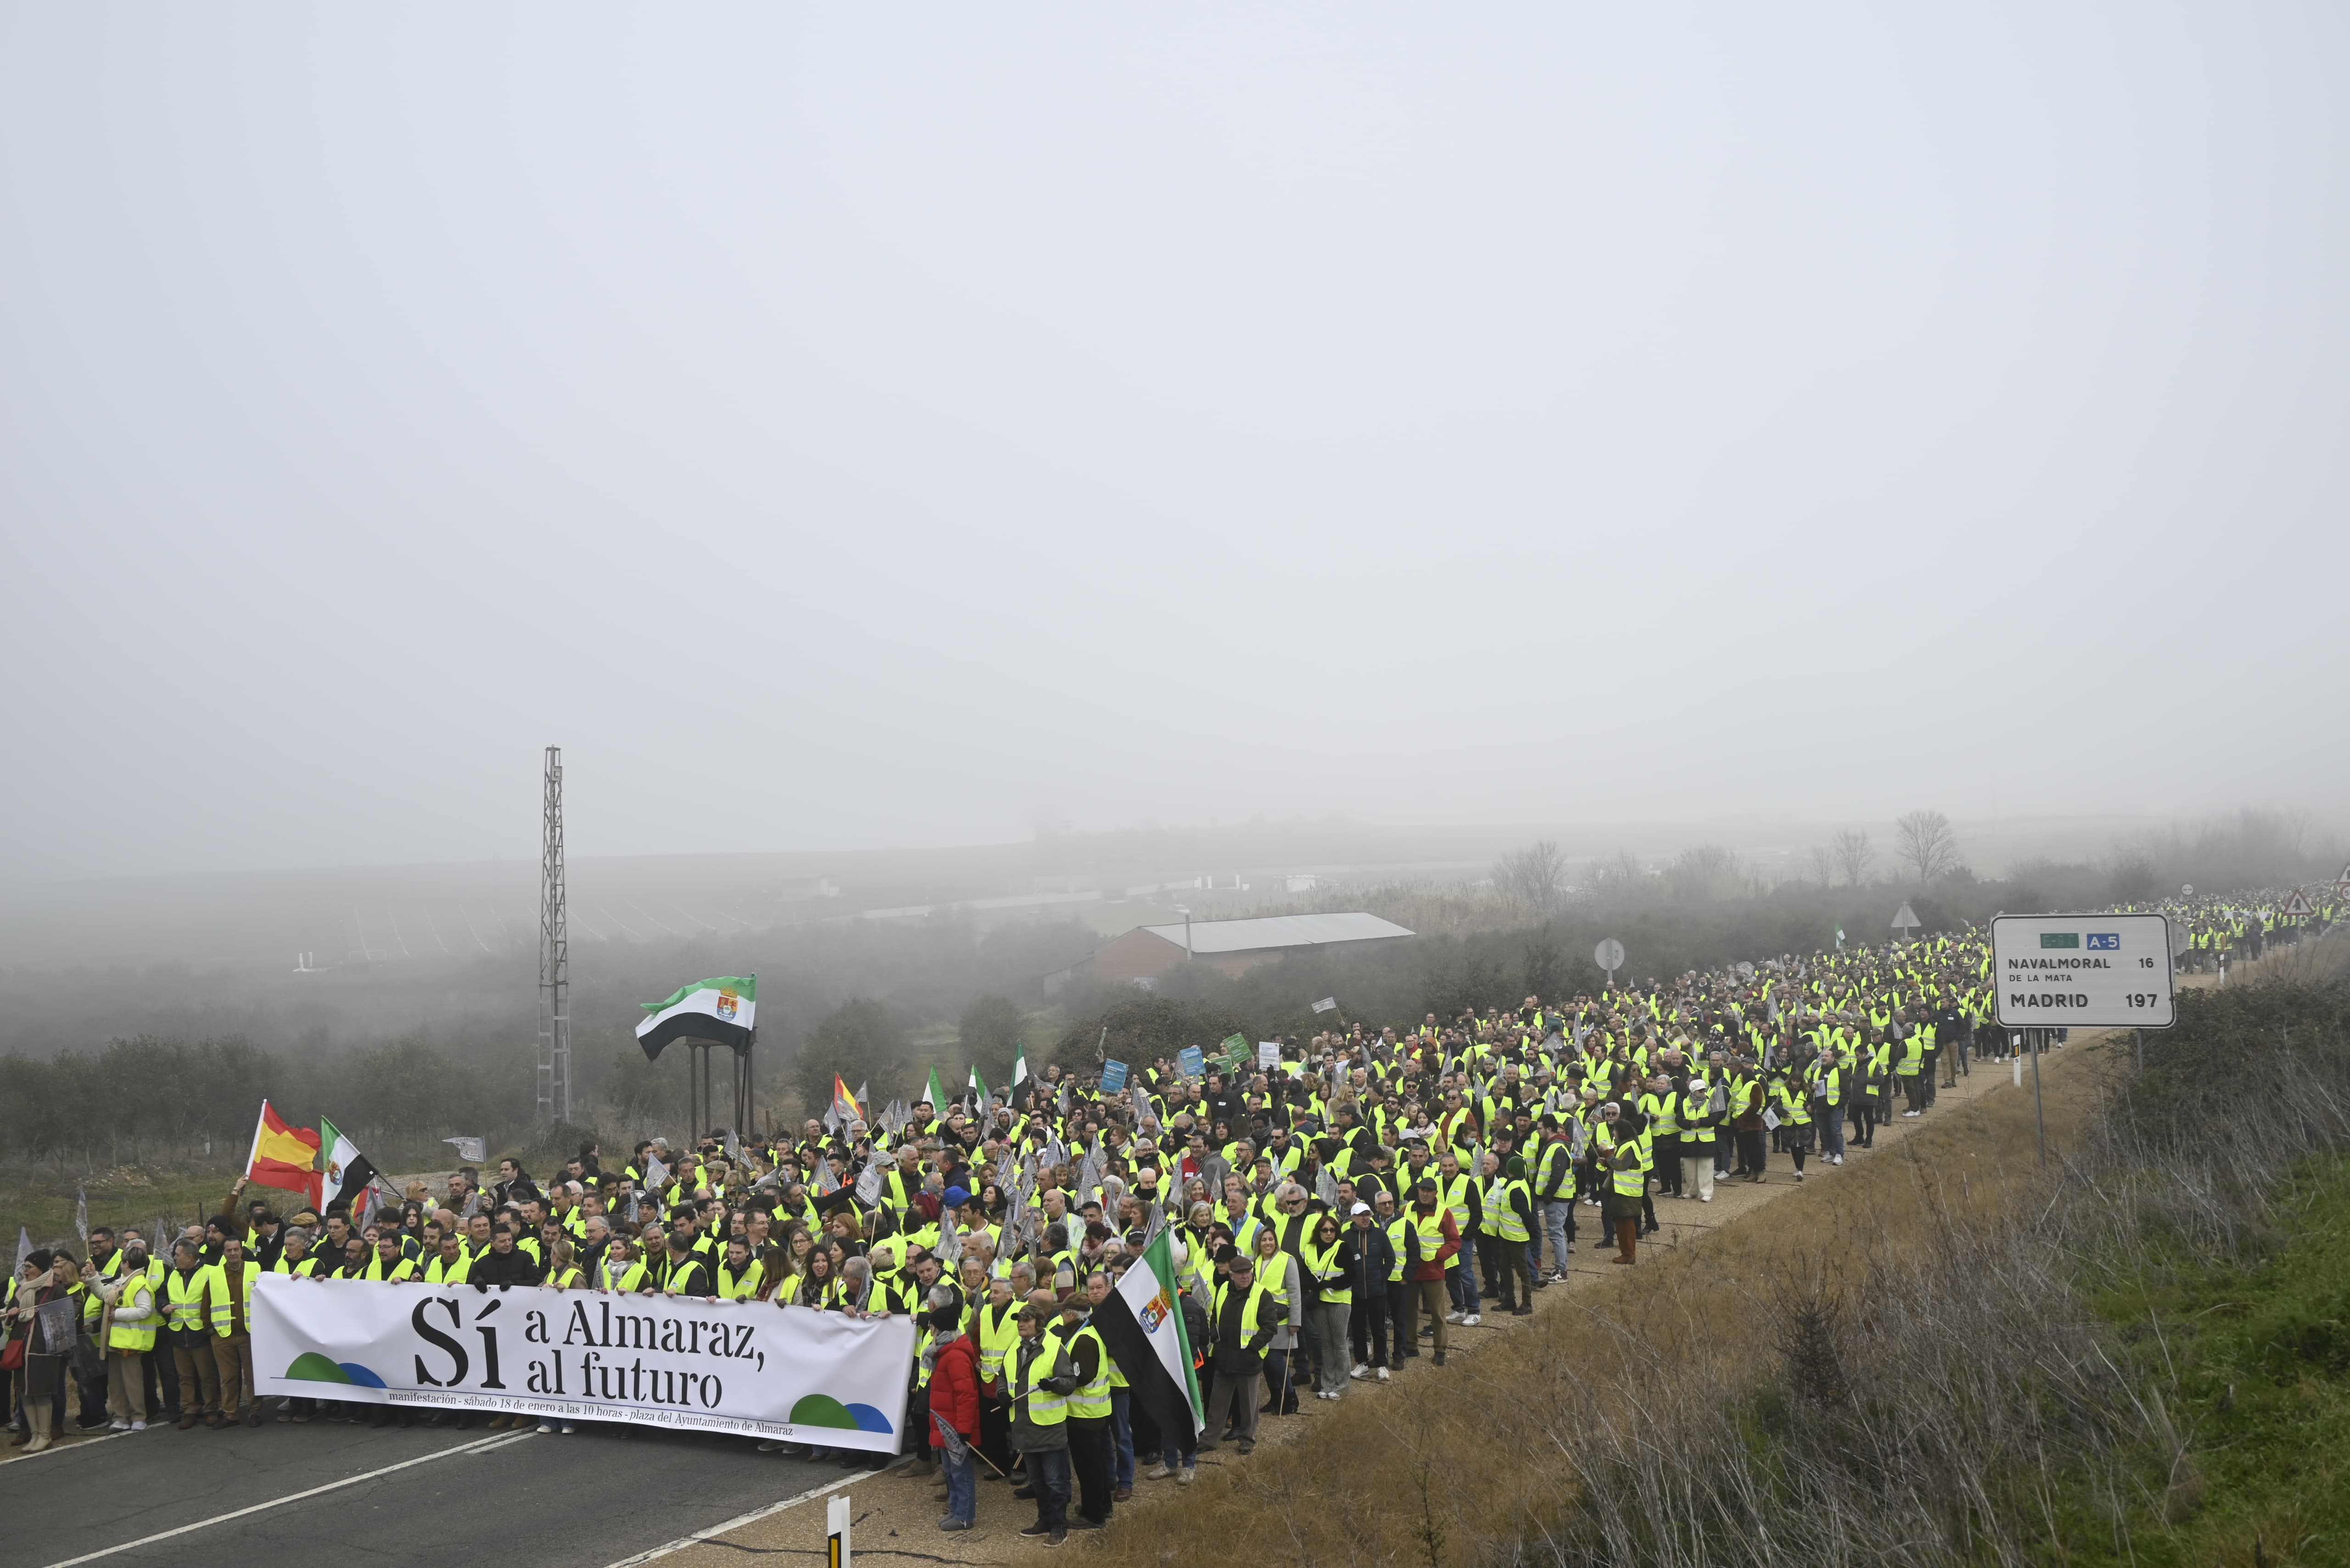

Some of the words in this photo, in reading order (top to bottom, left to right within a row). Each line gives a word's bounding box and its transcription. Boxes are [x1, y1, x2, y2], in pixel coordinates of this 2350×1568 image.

[2089, 936, 2118, 948] A-5
[2009, 958, 2111, 969] NAVALMORAL
[2139, 958, 2154, 968] 16
[2011, 993, 2088, 1008] MADRID
[2126, 993, 2158, 1008] 197
[412, 1296, 506, 1389] Sí
[525, 1311, 550, 1344] a
[563, 1300, 765, 1373] Almaraz,
[527, 1350, 566, 1395] al
[581, 1351, 722, 1409] futuro
[389, 1392, 456, 1404] manifestación
[464, 1396, 497, 1407] sábado
[500, 1398, 511, 1408] 18
[513, 1400, 525, 1409] de
[528, 1402, 555, 1412] enero
[566, 1403, 580, 1414] las
[583, 1405, 594, 1415] 10
[596, 1406, 622, 1417] horas
[629, 1409, 655, 1421] plaza
[658, 1412, 672, 1423] del
[675, 1413, 739, 1429] Ayuntamiento
[742, 1420, 752, 1431] de
[755, 1422, 793, 1436] Almaraz
